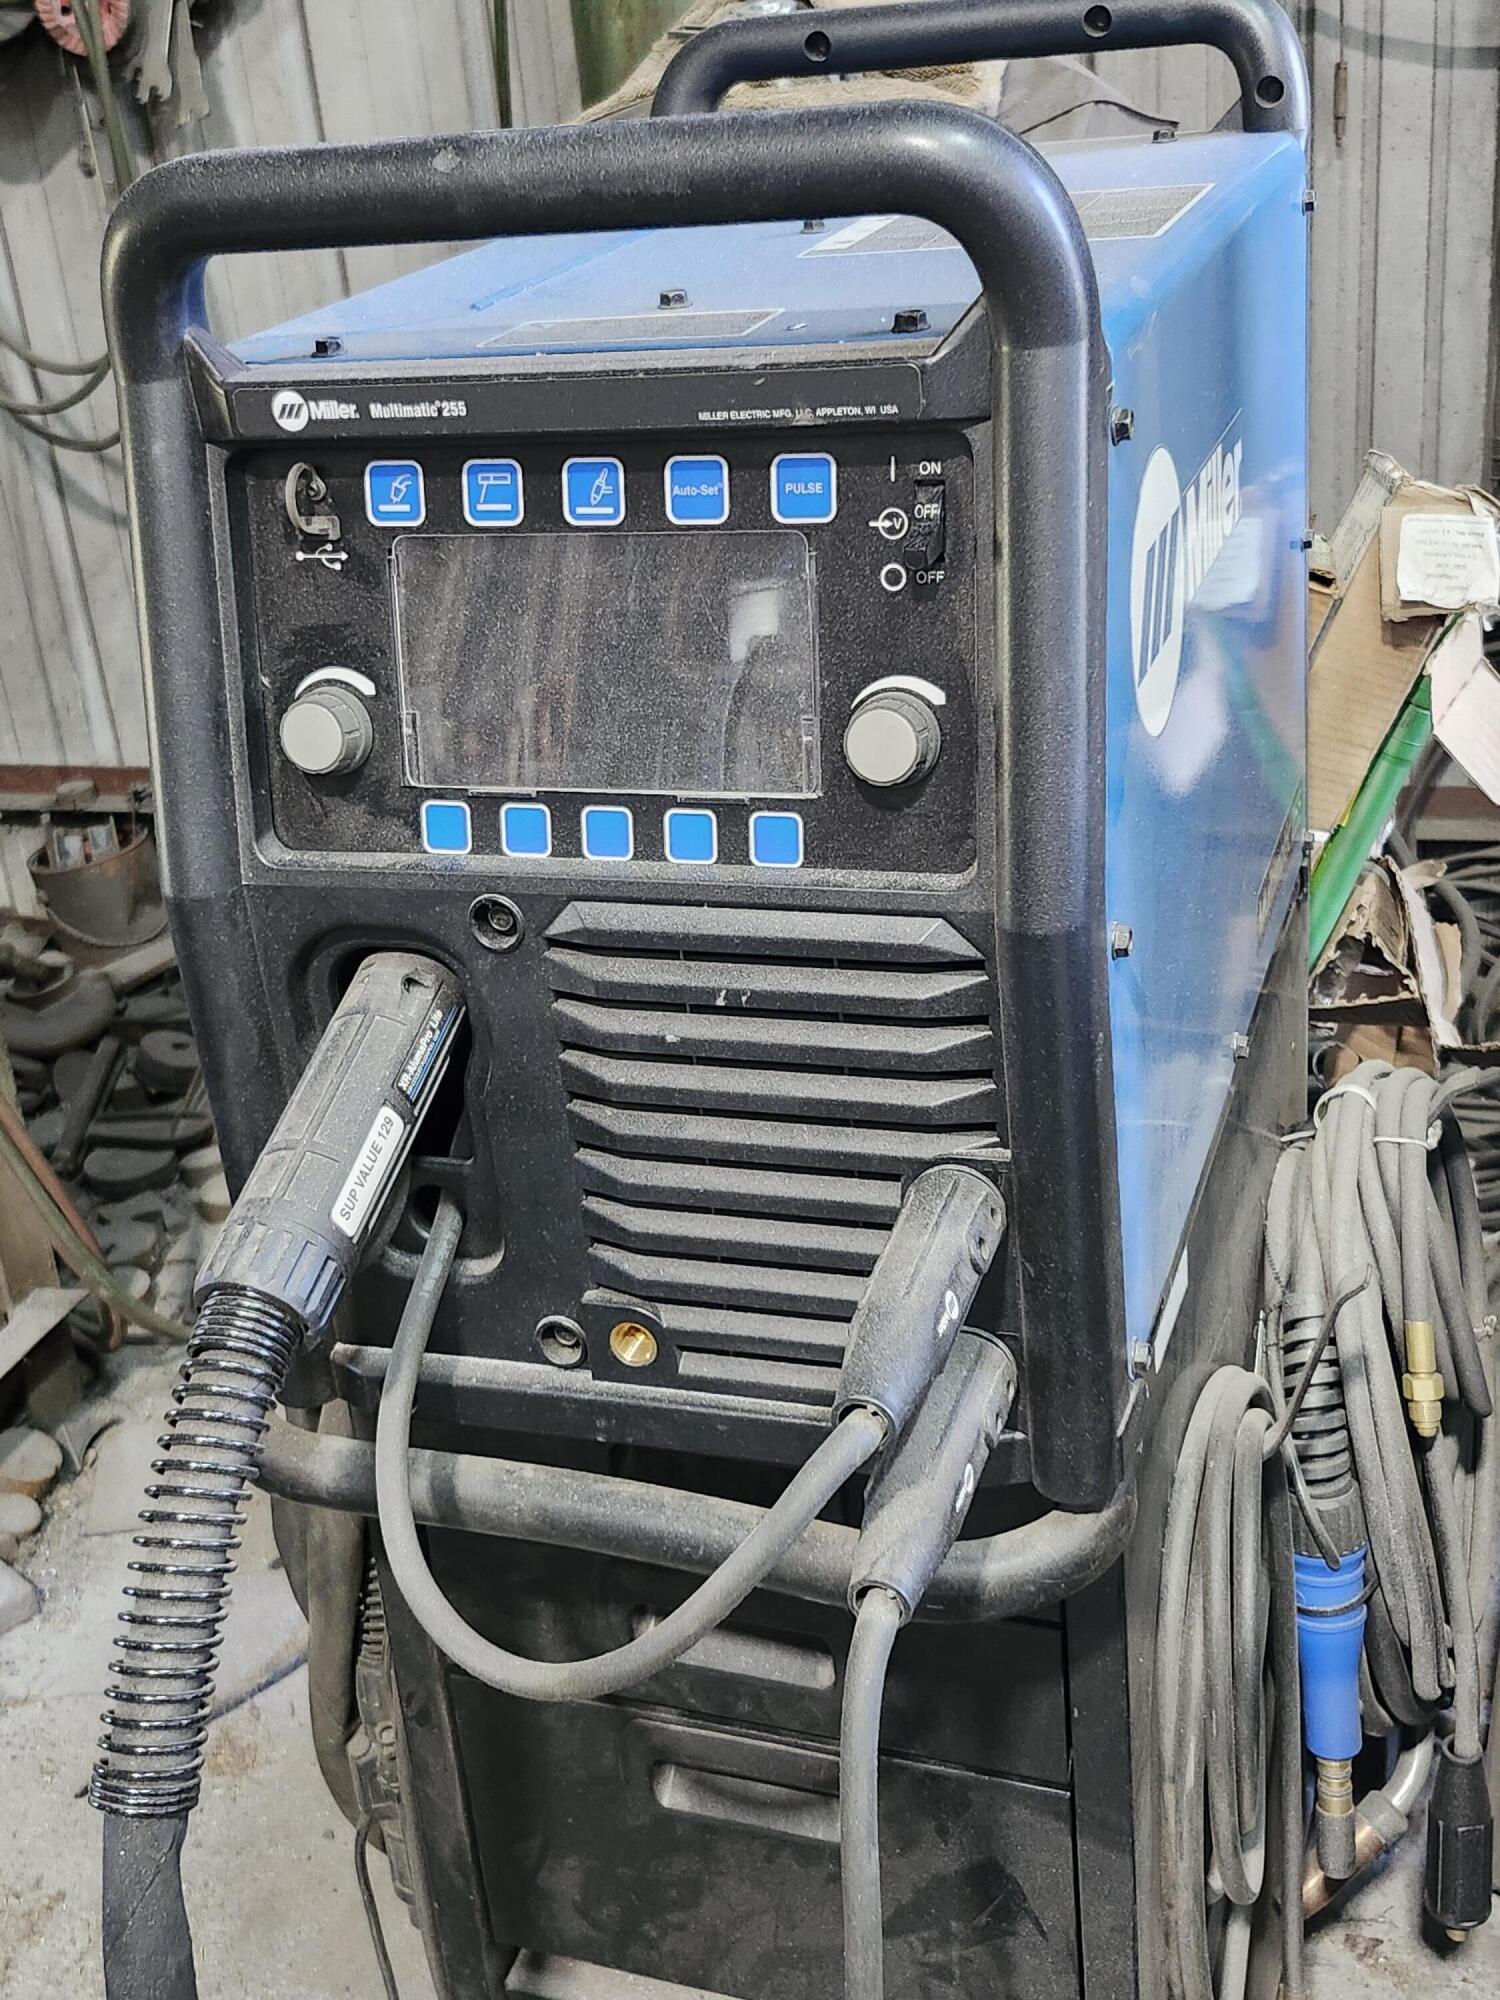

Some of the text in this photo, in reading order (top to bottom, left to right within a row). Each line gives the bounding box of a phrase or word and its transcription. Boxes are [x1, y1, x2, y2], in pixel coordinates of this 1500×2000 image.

[441, 400, 467, 418] 255
[698, 411, 729, 421] MILLER
[730, 409, 772, 420] ELECTRIC
[815, 406, 864, 417] APPLETON,
[864, 406, 876, 415] WI
[880, 405, 898, 415] USA
[919, 461, 941, 475] ON
[785, 482, 824, 495] PULSE
[914, 503, 939, 519] OFF
[916, 570, 945, 584] OFF
[340, 1116, 394, 1221] SUP VALUE 129
